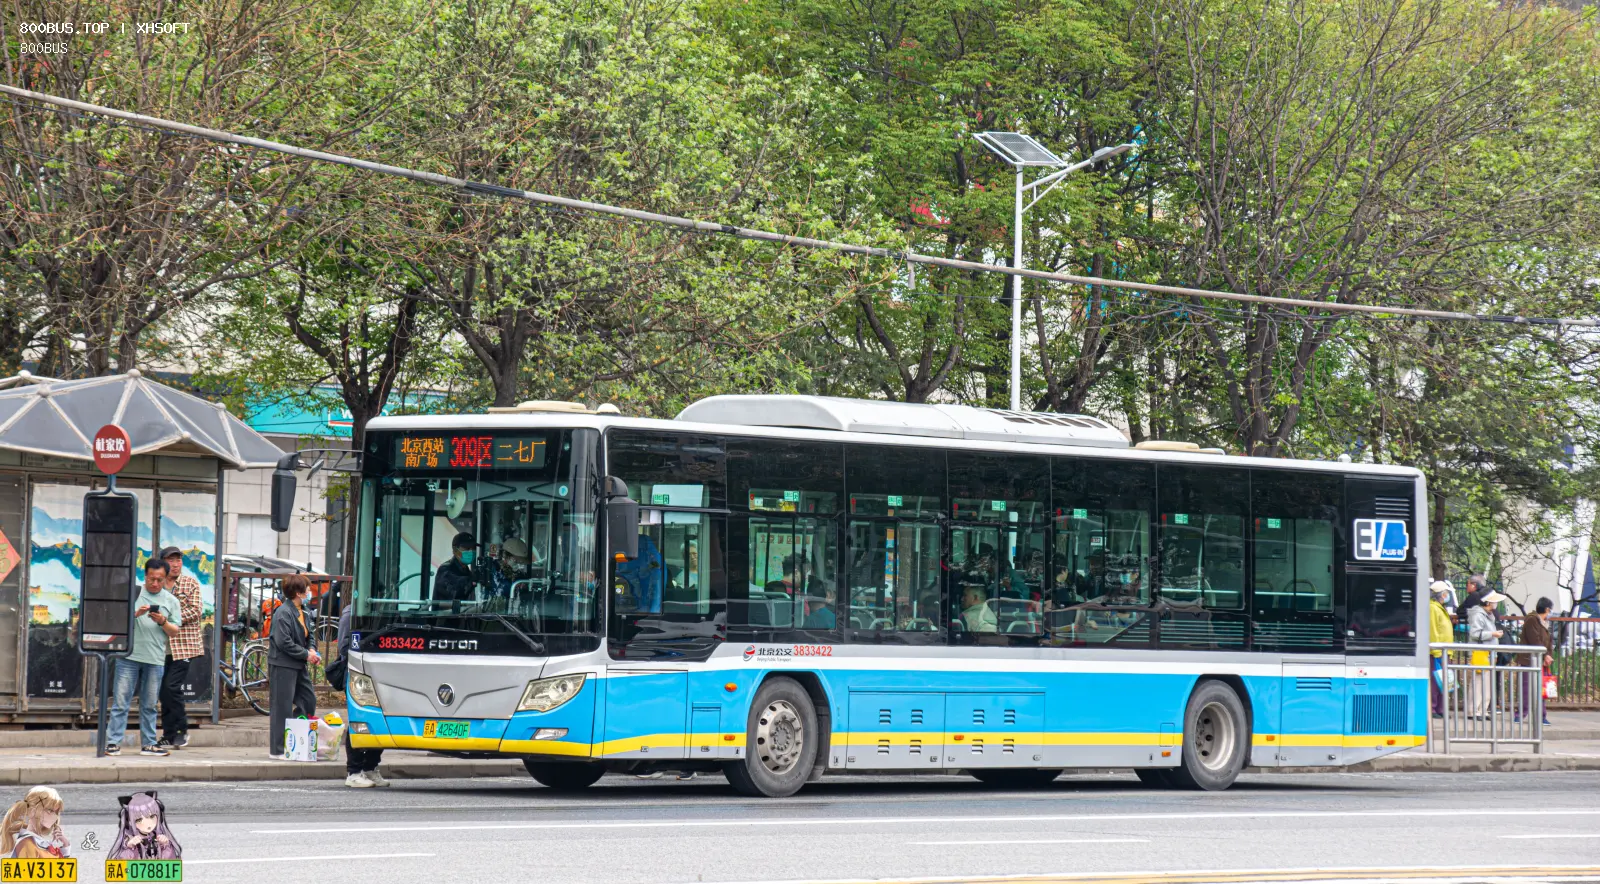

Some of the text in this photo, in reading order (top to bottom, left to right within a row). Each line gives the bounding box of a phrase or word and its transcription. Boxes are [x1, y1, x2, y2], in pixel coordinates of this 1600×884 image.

[95, 437, 125, 452] 杜家坎
[401, 437, 546, 467] 北京西站 309区 二七厂
[405, 453, 439, 468] 南广场
[378, 636, 478, 651] 3833422 FOTON
[757, 645, 832, 657] 北京公交 3833422
